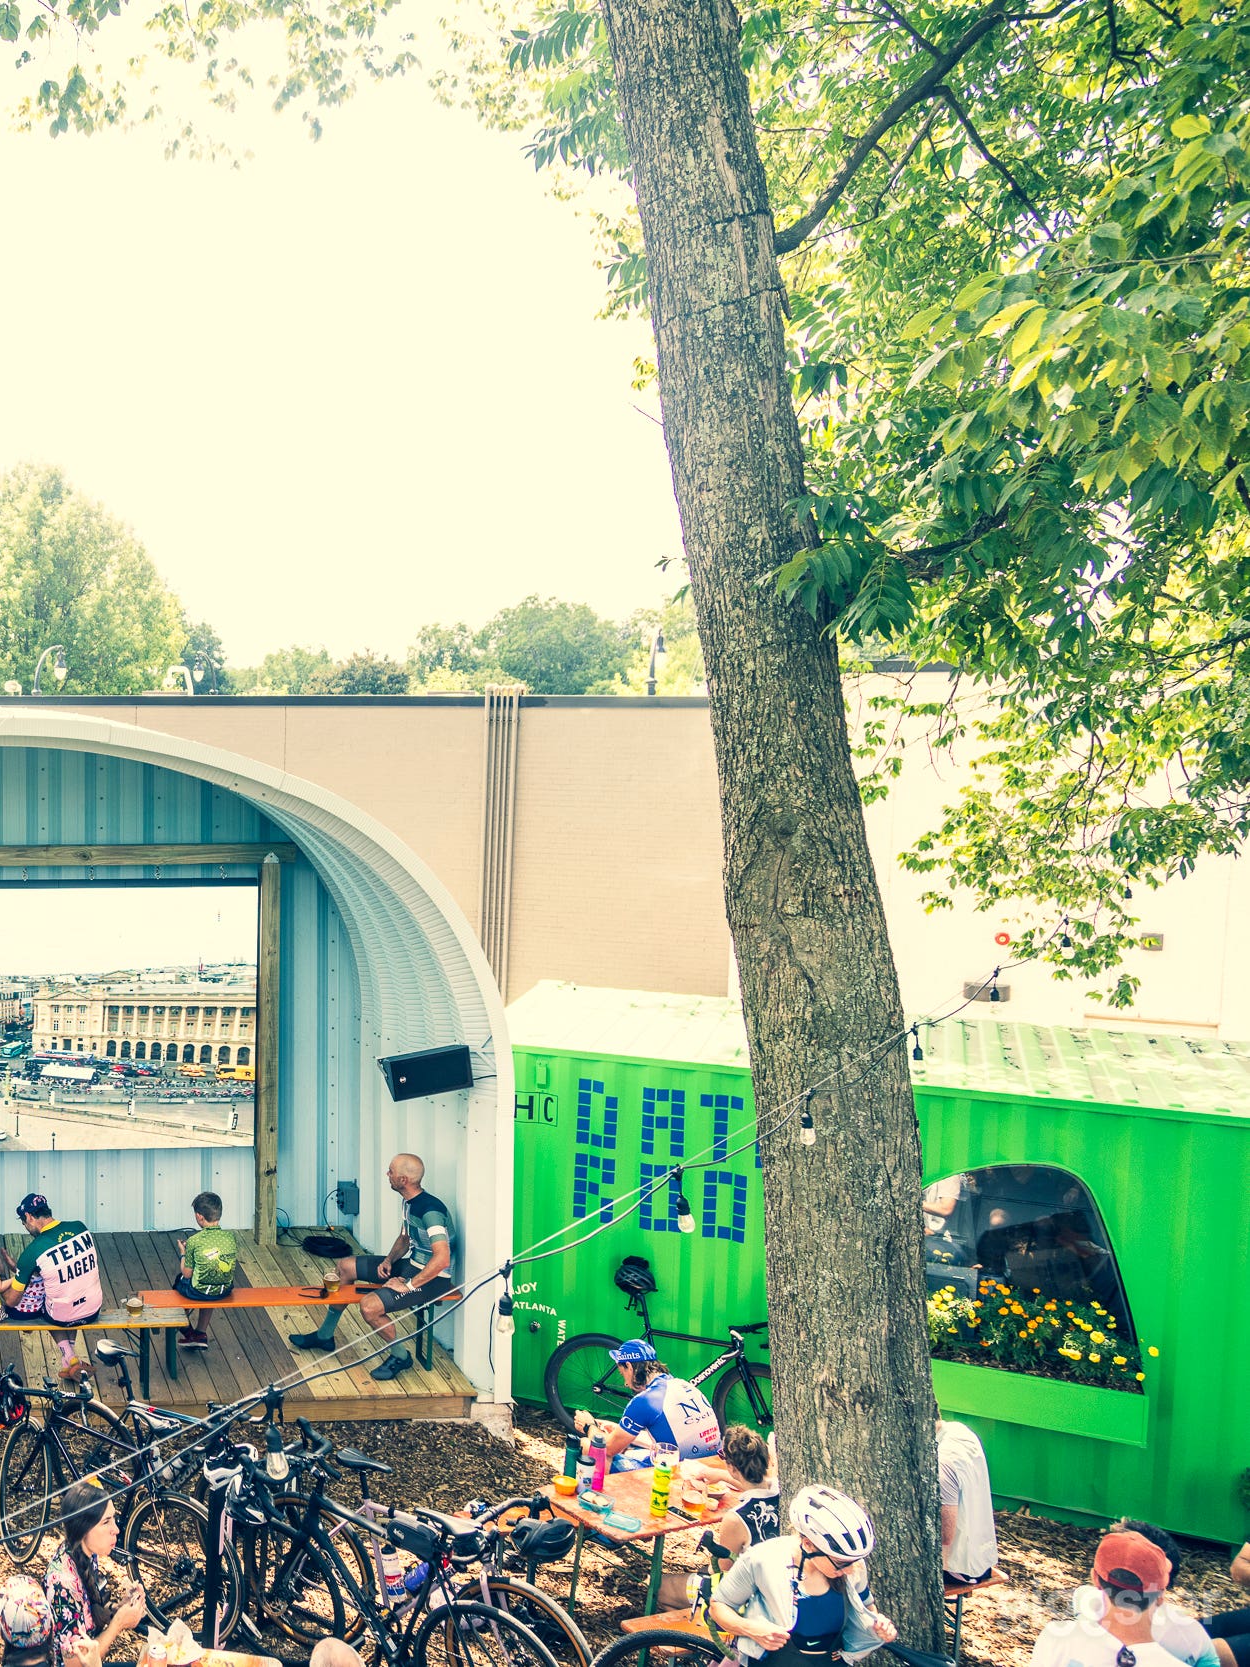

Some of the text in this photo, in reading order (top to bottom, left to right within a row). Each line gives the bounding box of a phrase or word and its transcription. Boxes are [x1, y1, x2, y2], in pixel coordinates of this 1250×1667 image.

[46, 1233, 93, 1266] TEAM
[58, 1253, 96, 1284] LAGER
[511, 1281, 537, 1295] JOY
[512, 1301, 557, 1316] ATLANTA
